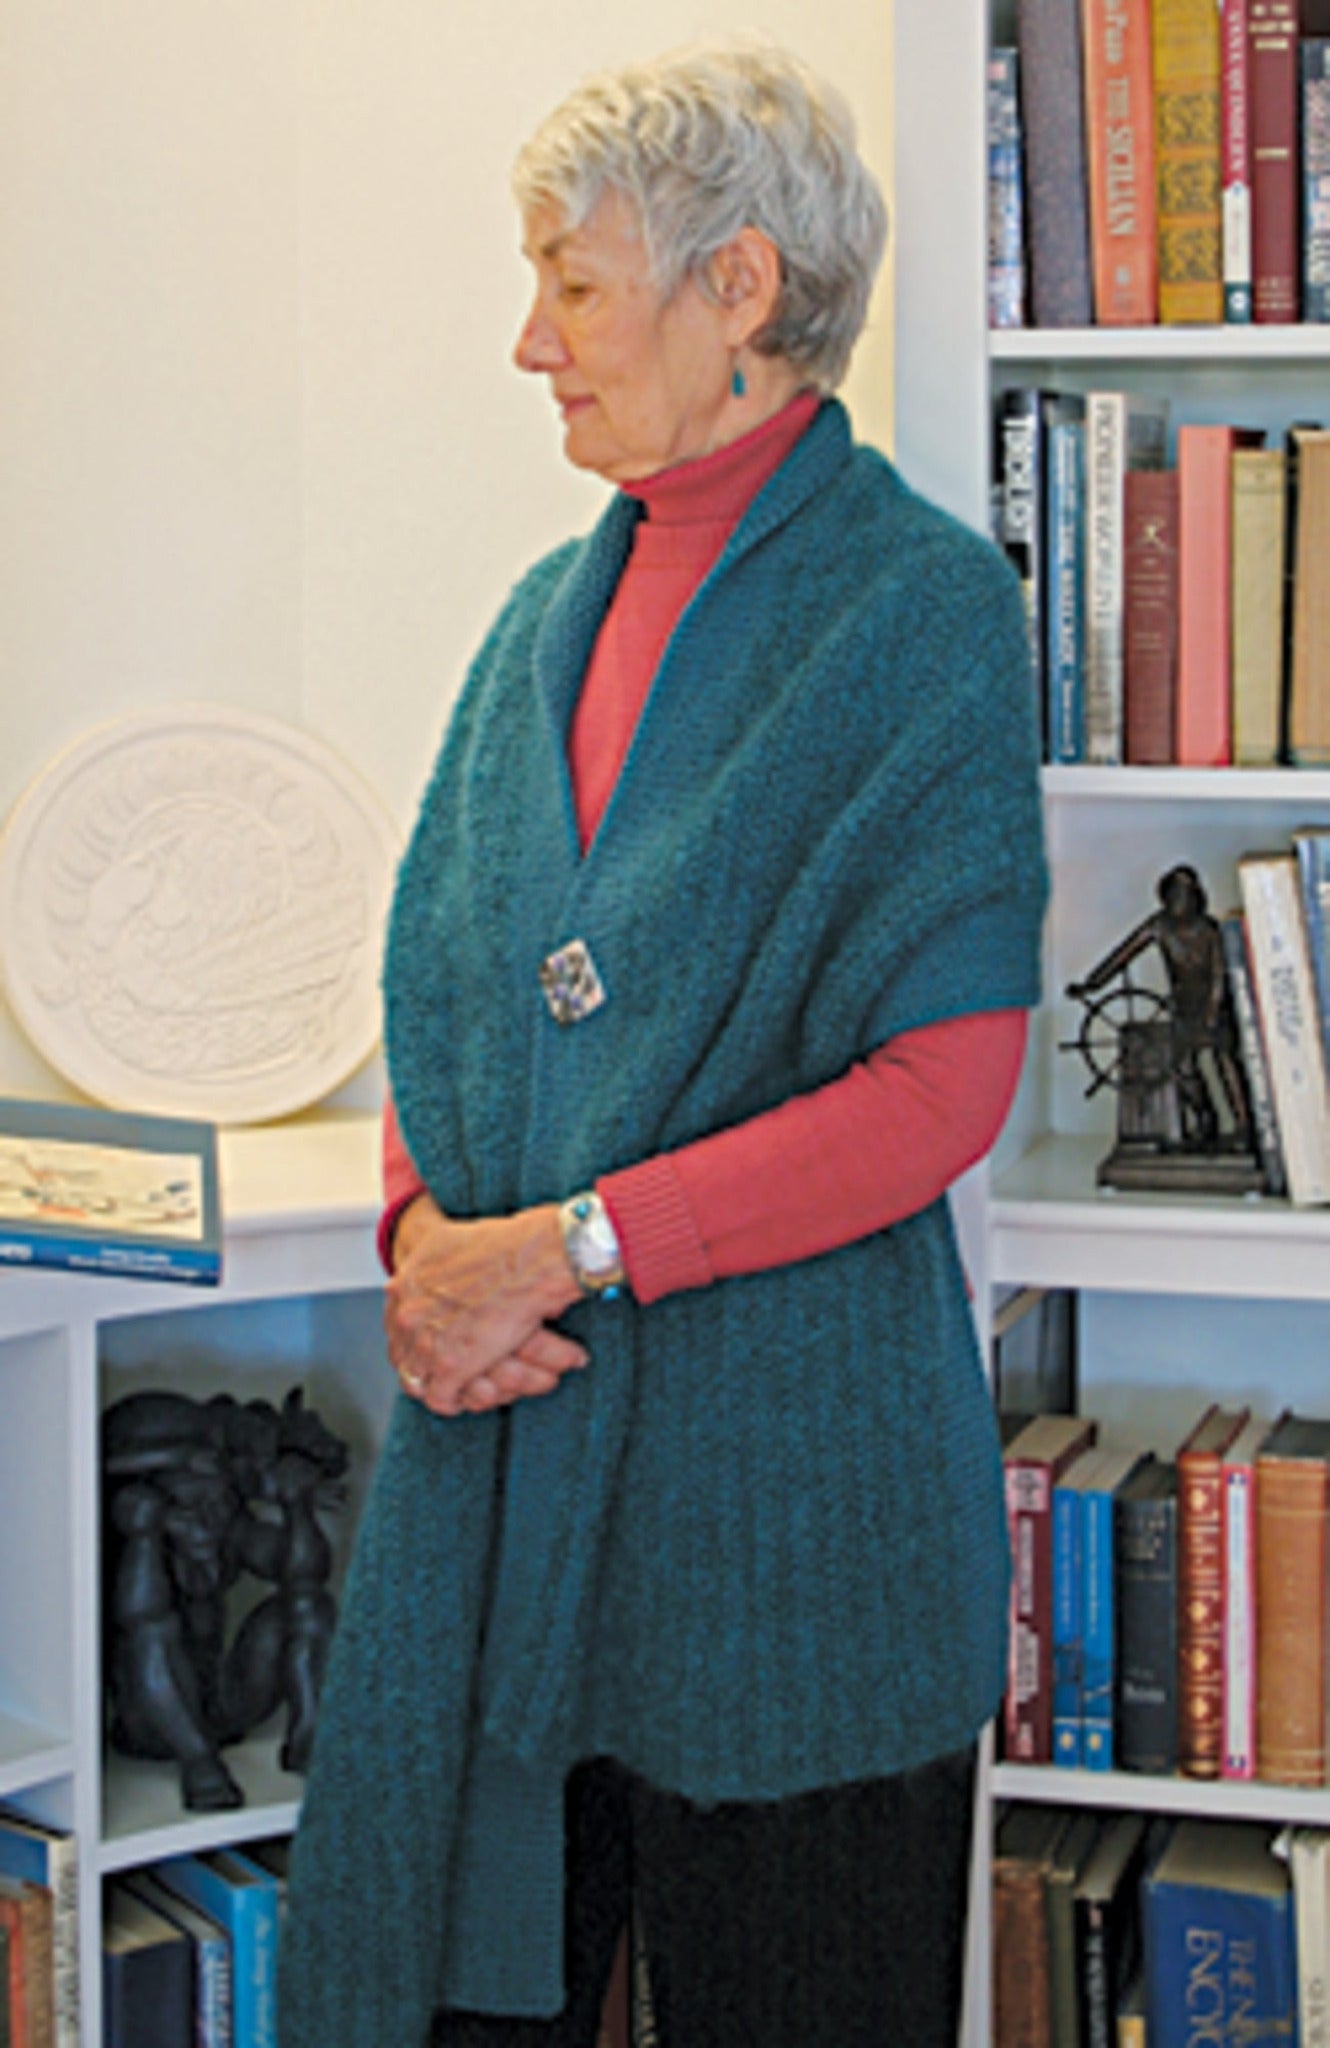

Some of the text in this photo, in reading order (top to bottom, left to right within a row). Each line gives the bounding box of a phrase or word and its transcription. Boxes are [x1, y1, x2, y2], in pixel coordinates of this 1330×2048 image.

[1106, 76, 1136, 235] THE SICILIAN
[1229, 1939, 1256, 1990] THE
